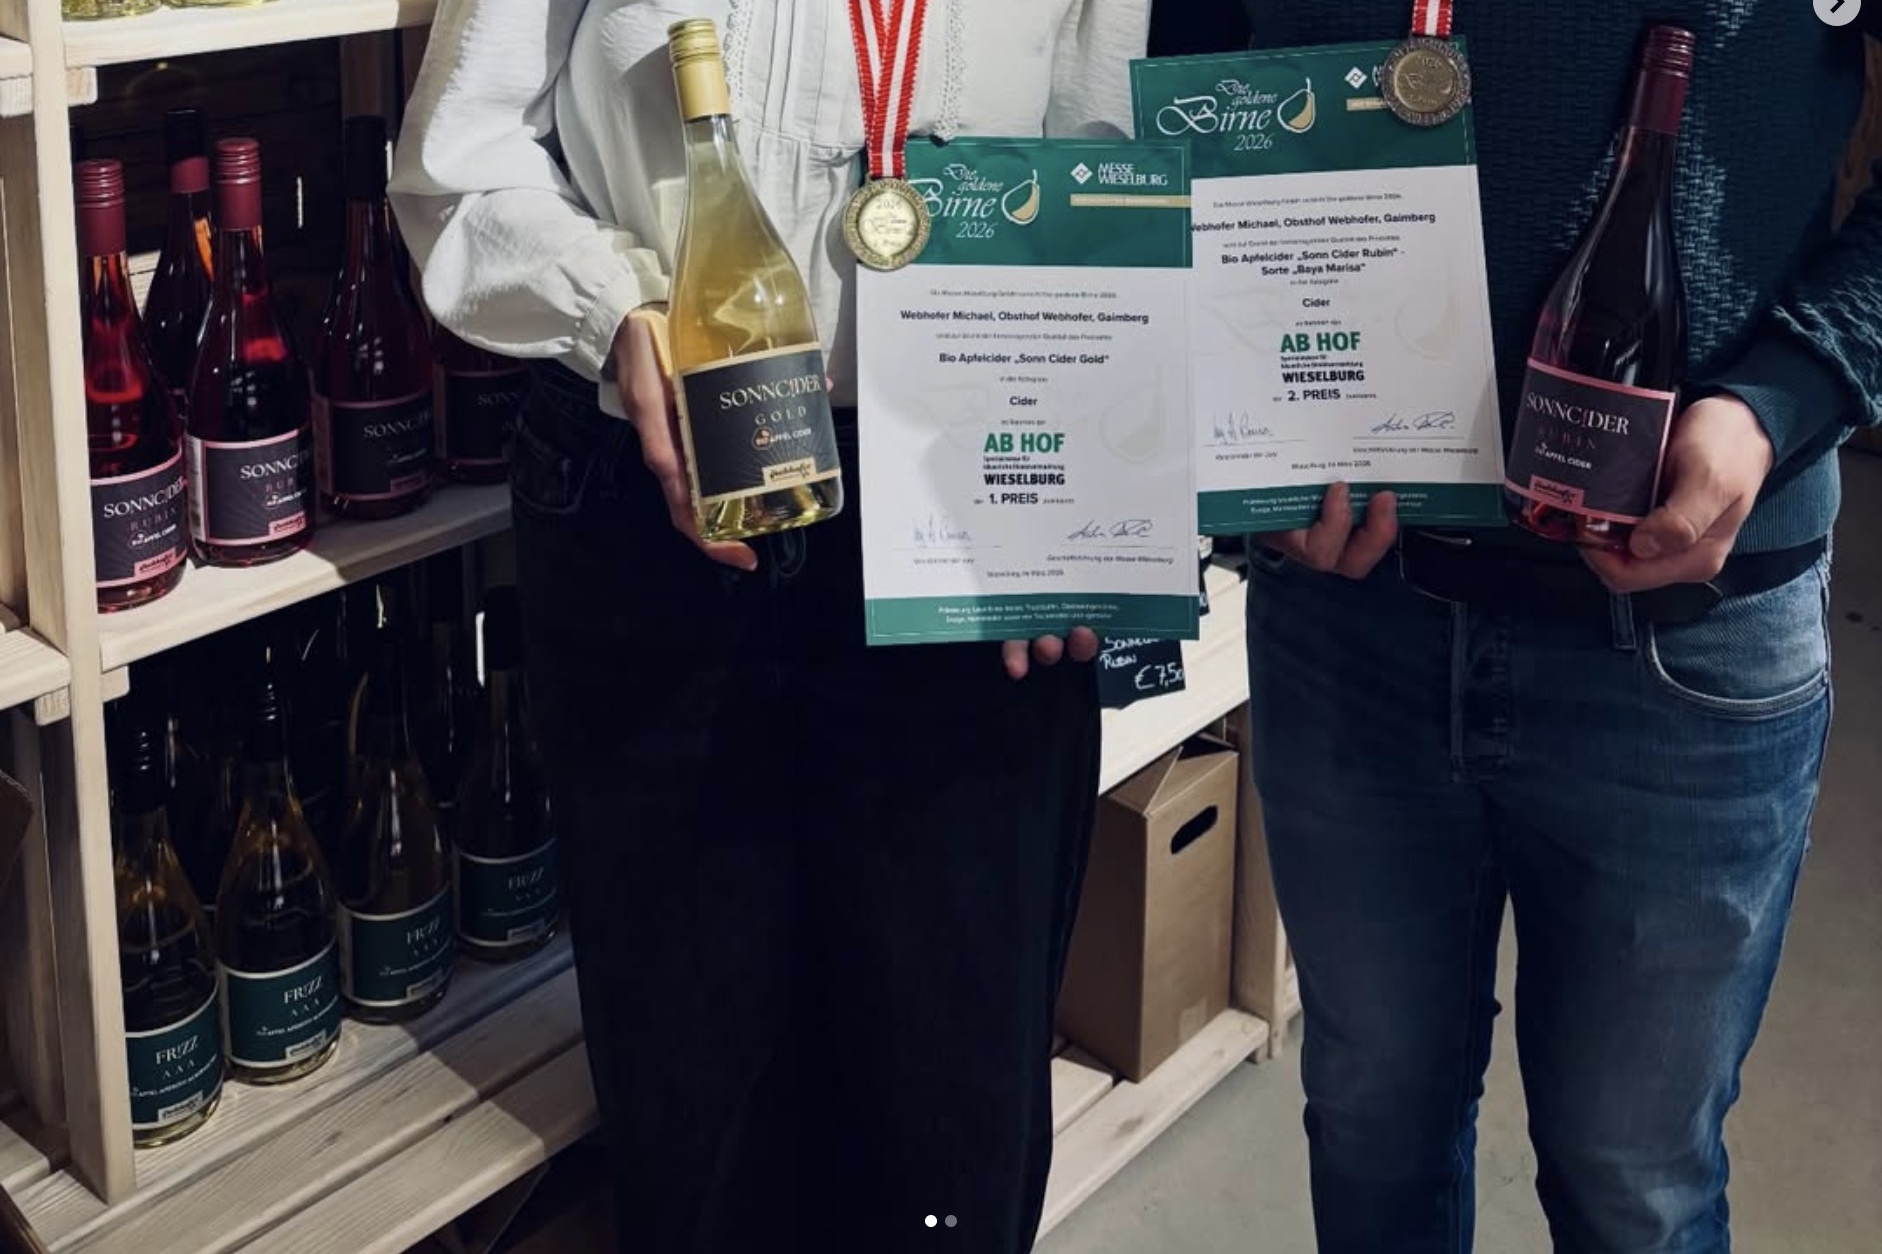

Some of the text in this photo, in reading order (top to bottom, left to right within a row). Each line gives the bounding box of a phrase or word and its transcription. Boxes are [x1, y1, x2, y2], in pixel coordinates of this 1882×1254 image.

[1155, 94, 1273, 136] Birne
[1233, 132, 1274, 151] 2026
[1098, 172, 1168, 186] WIESELBURG
[907, 177, 998, 219] Birne
[1237, 219, 1282, 231] Michael,
[1283, 215, 1327, 227] Obsthof
[1328, 215, 1381, 226] Webhofer,
[1384, 212, 1436, 225] Gaimberg
[955, 221, 998, 239] 2026
[1221, 254, 1238, 265] Bio
[1240, 252, 1294, 265] Apfelcider
[1331, 248, 1361, 260] Cider
[1261, 264, 1291, 276] Sorte
[1302, 297, 1331, 308] Cider
[900, 309, 1150, 325] Webhofer Michael, Obsthof Webhofer, Gaimberg
[1279, 331, 1361, 353] AB HOF
[938, 353, 956, 364] Bio
[958, 353, 1011, 366] Apfelcider
[1048, 354, 1077, 364] Cider
[1281, 370, 1366, 384] WIESELBURG
[1009, 396, 1038, 407] Cider
[1287, 389, 1301, 402] 2.
[1302, 388, 1342, 401] PREIS
[754, 405, 807, 426] GOLD
[983, 432, 1066, 453] AB HOF
[1567, 457, 1592, 470] CIDER
[983, 473, 1066, 486] WIESELBURG
[988, 493, 999, 506] 1.
[1001, 493, 1039, 506] PREIS
